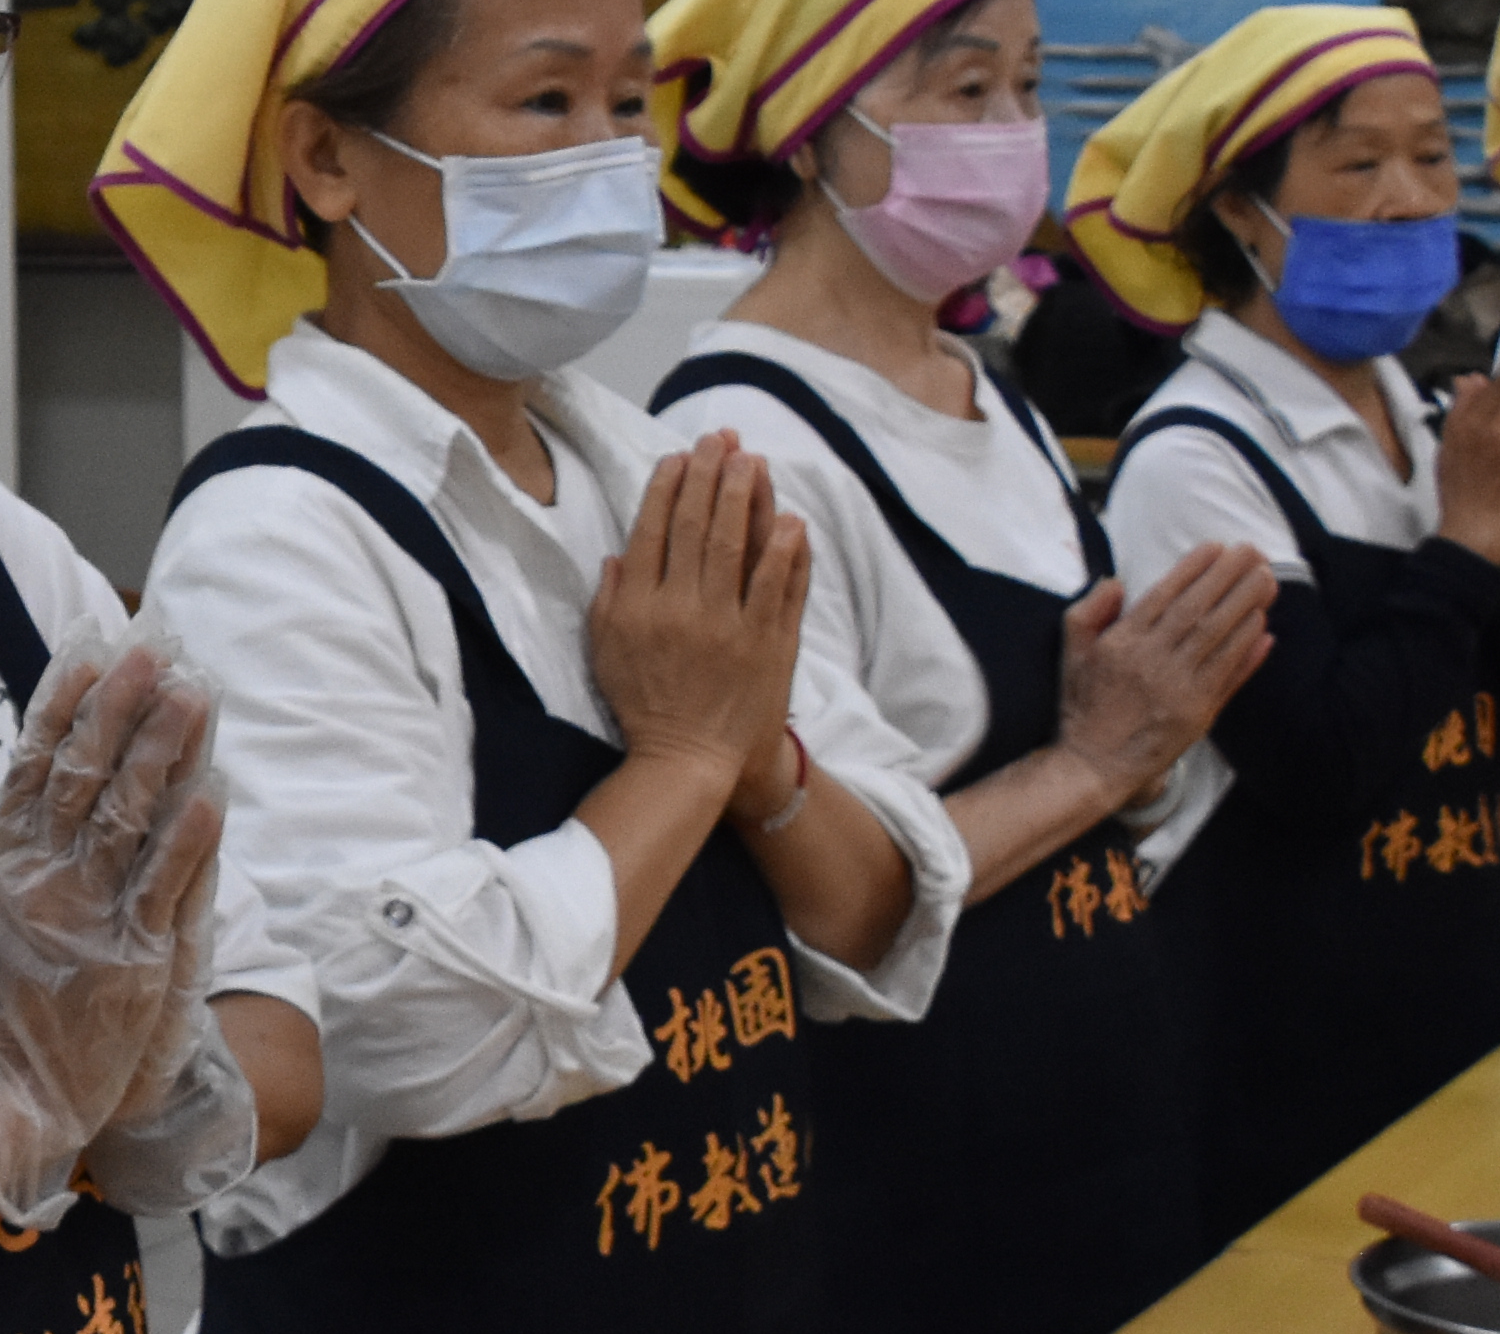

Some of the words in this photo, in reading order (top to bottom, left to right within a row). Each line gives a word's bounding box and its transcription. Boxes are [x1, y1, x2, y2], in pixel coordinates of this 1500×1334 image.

[655, 946, 795, 1083] 桃園
[596, 1092, 813, 1256] 佛教蓮
